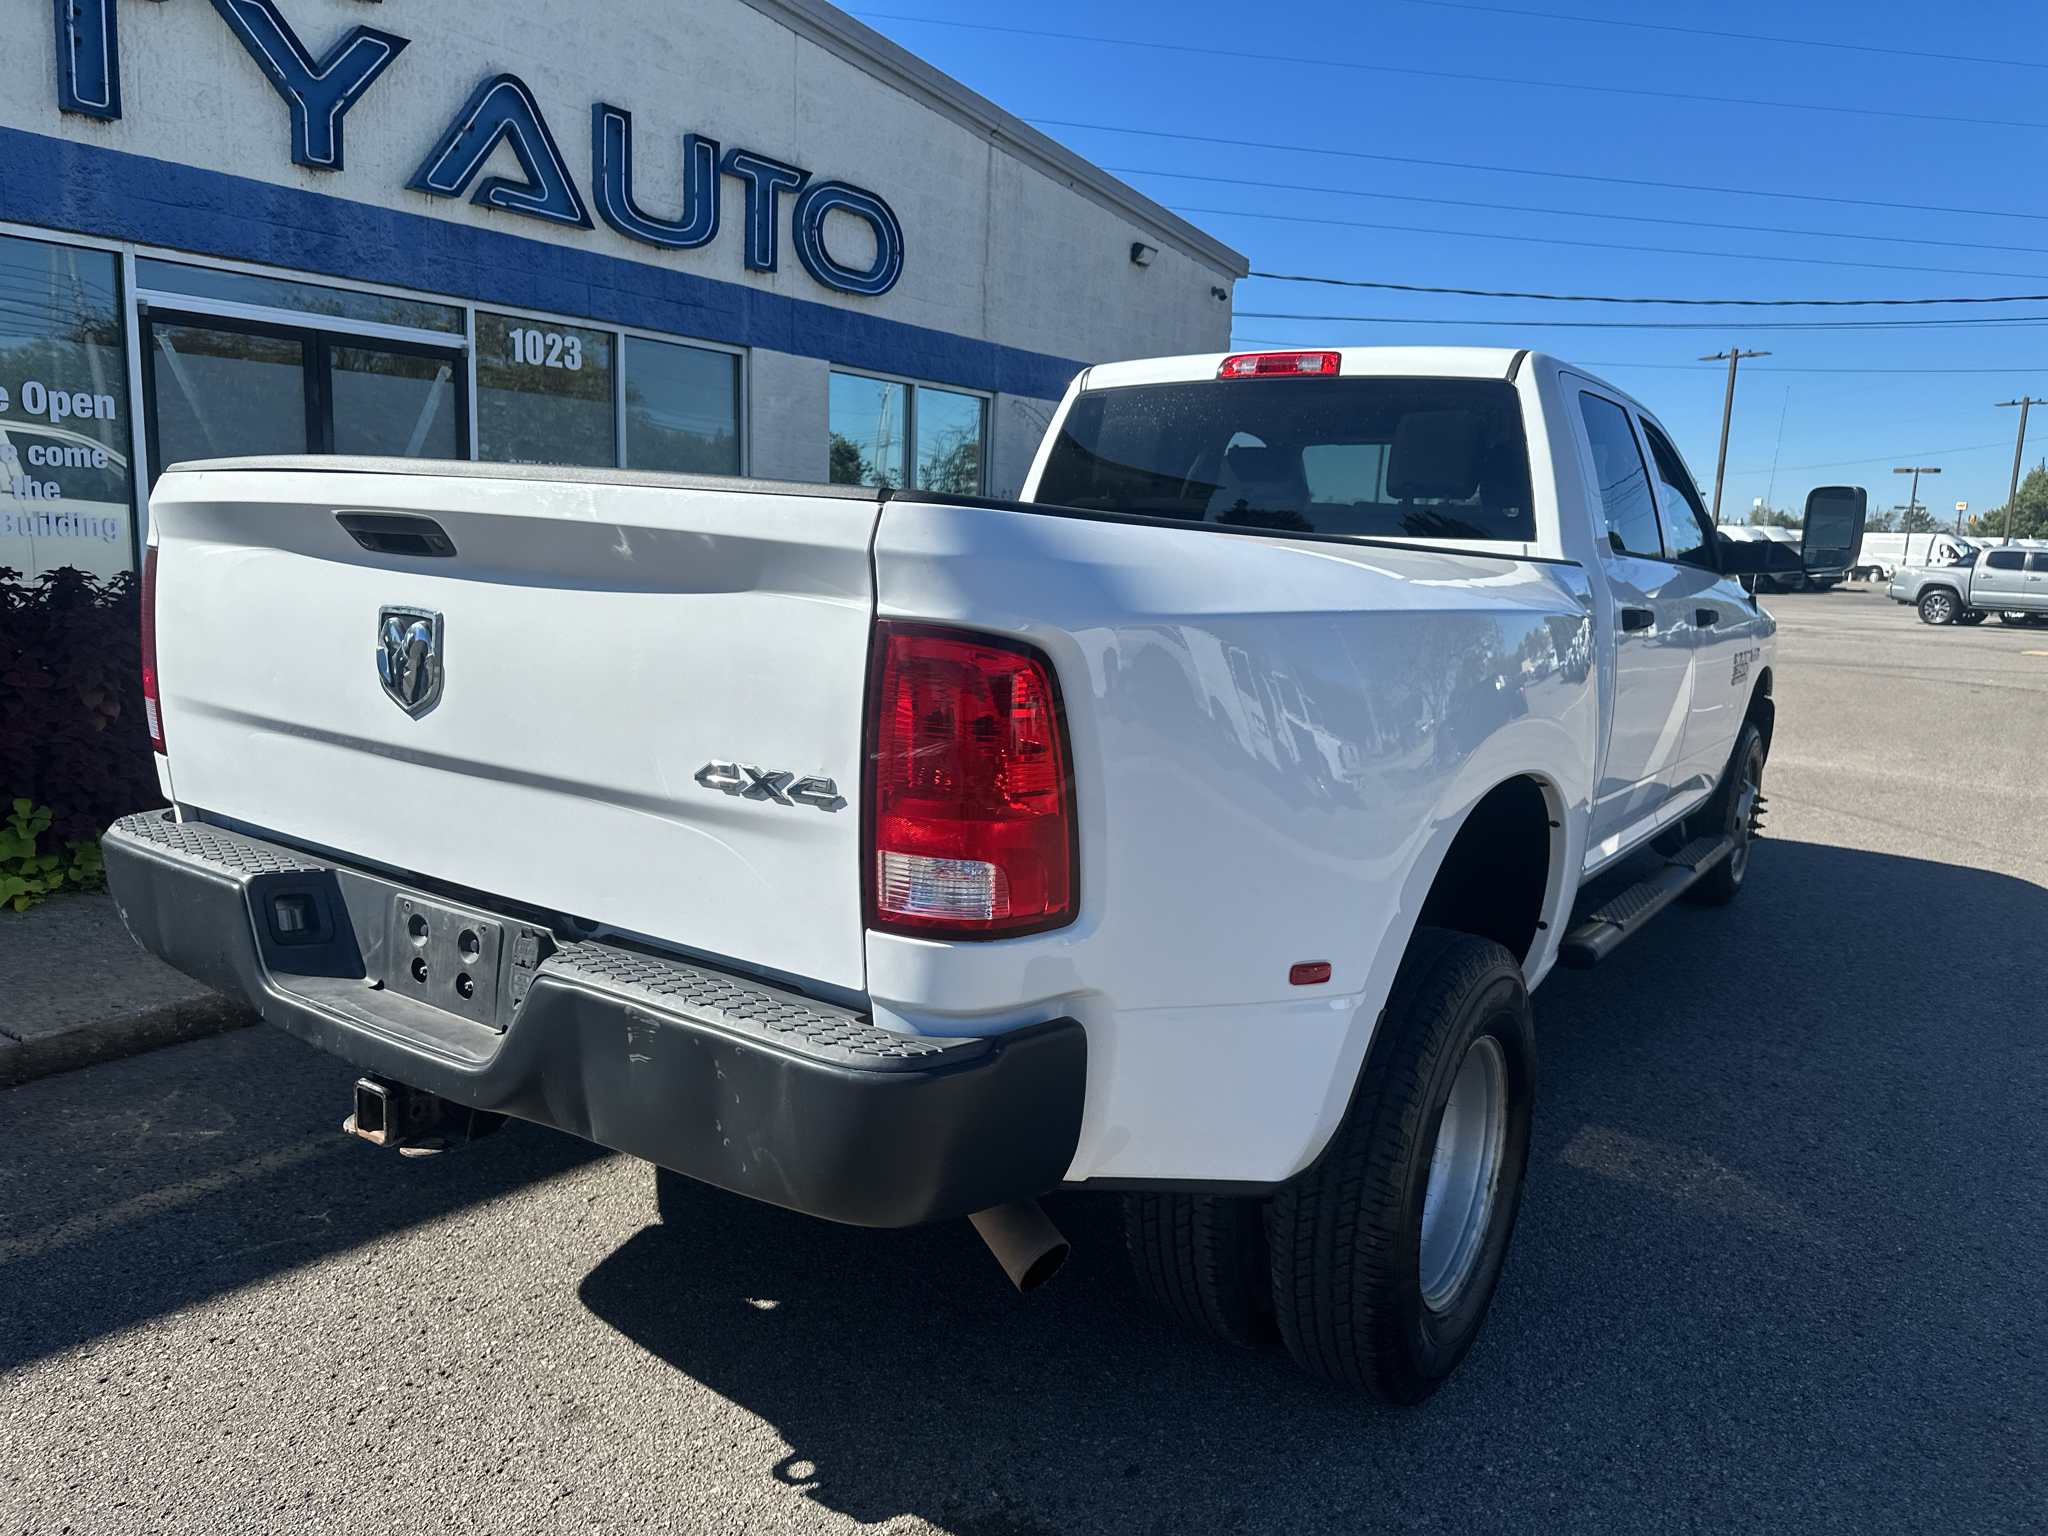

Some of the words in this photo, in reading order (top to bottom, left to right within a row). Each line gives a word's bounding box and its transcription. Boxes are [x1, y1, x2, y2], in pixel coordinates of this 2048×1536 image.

[509, 328, 582, 371] 1023
[22, 381, 115, 423] Open
[28, 445, 108, 469] come
[11, 475, 61, 501] the
[0, 511, 120, 543] Building
